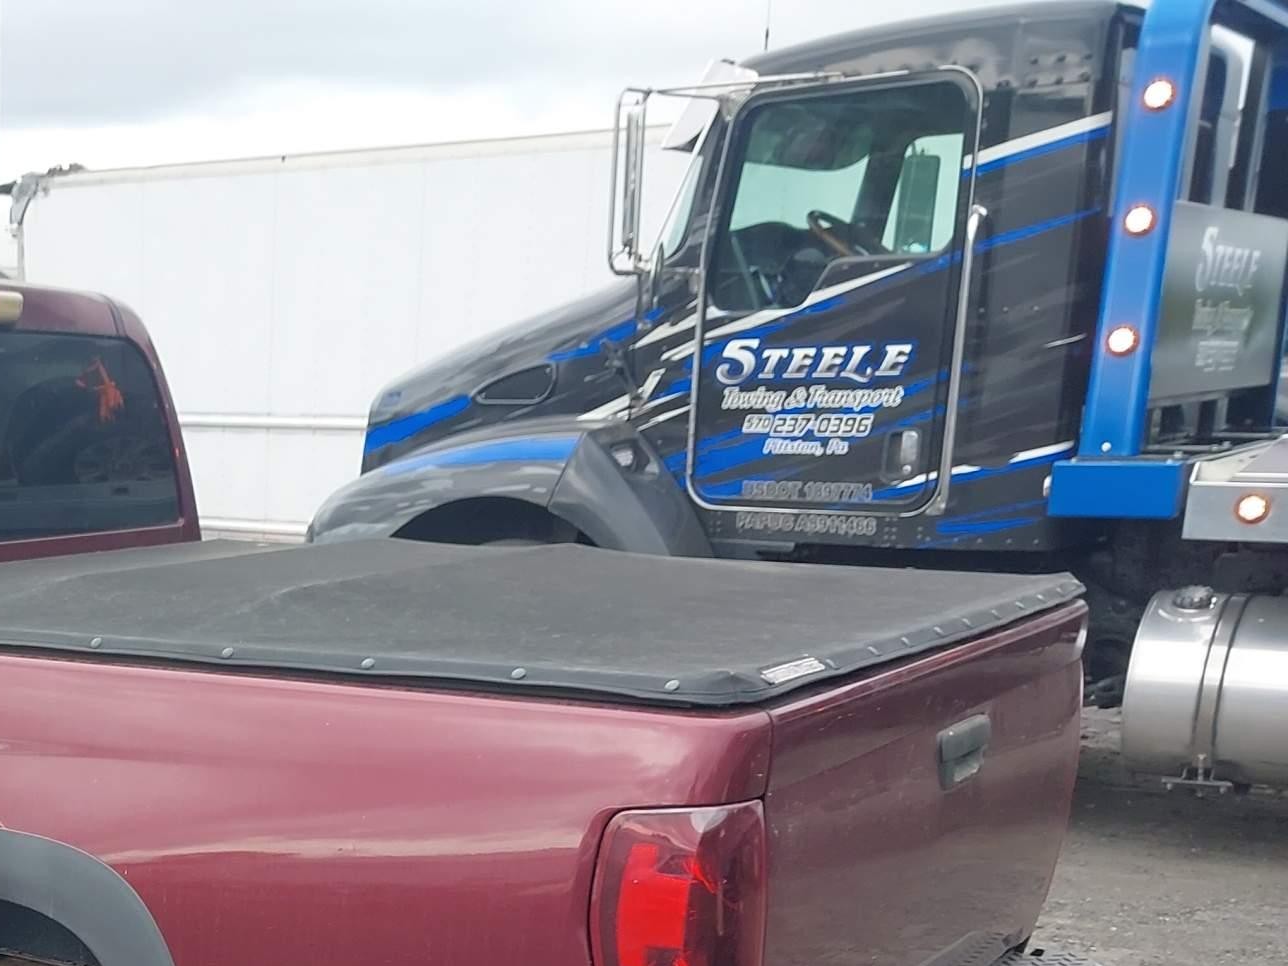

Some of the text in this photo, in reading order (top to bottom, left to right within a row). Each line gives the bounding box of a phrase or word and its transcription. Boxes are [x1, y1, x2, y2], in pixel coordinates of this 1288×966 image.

[1194, 226, 1261, 296] STEELE
[715, 338, 912, 384] STEELE
[721, 384, 904, 413] Towing & Transport
[742, 413, 873, 437] 570 237-0396
